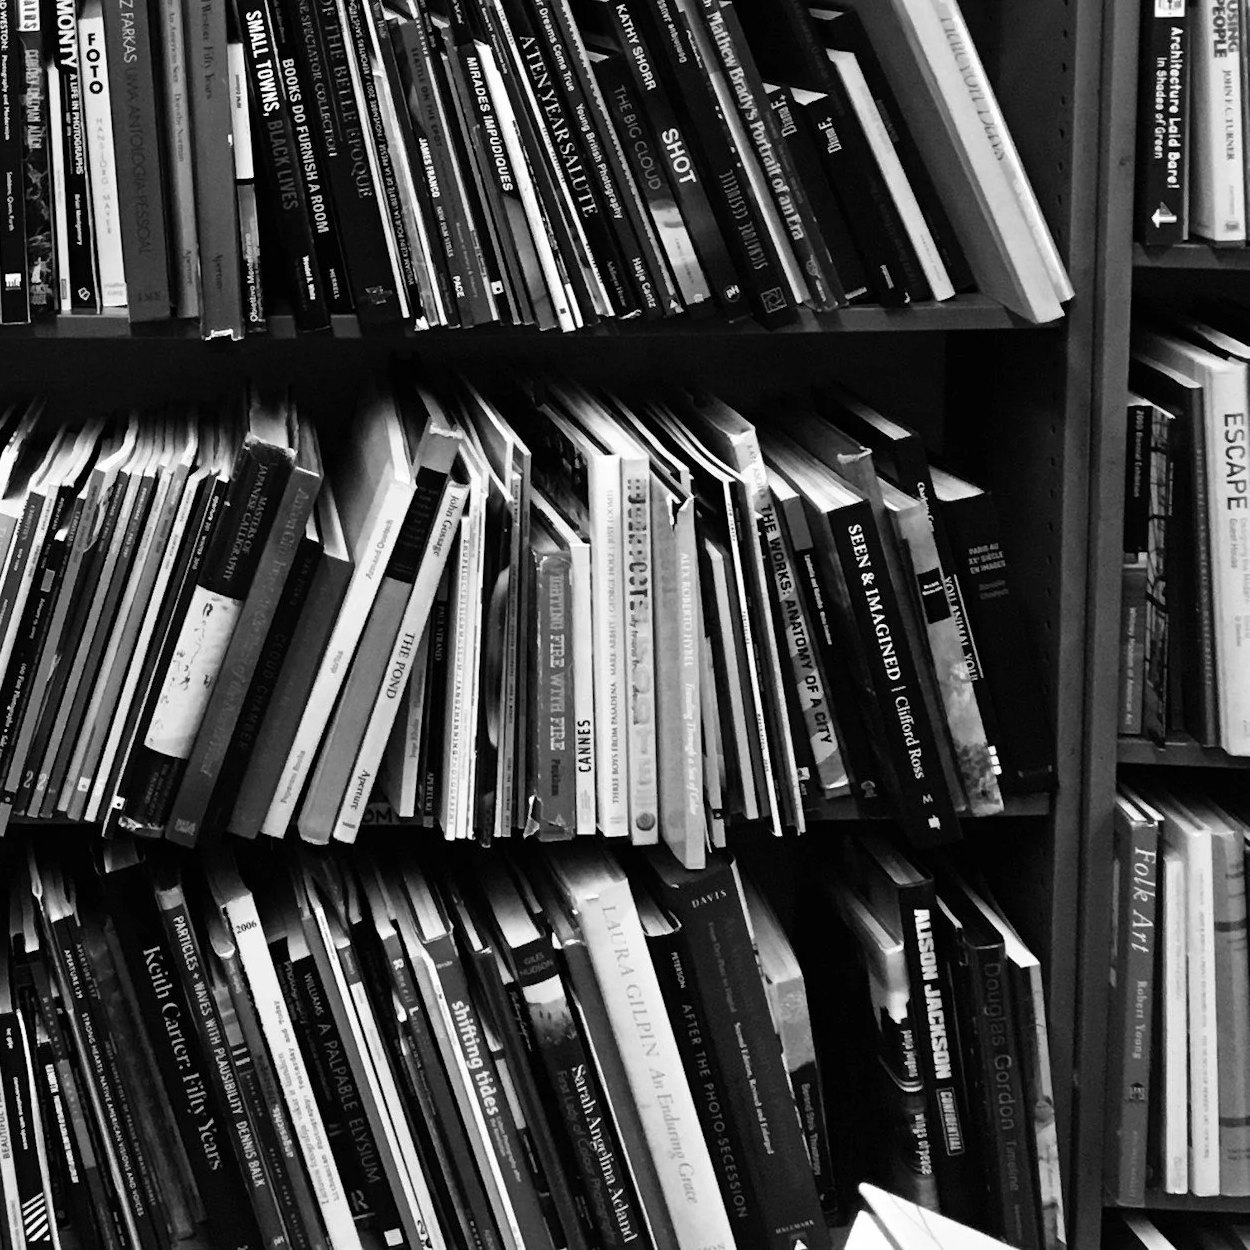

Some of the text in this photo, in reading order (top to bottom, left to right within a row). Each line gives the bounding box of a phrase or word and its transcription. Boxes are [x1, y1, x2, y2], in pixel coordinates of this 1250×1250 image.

[122, 12, 137, 63] FARKAS
[245, 10, 280, 117] SMALL TOWNS,
[467, 56, 492, 112] MIRADES
[615, 4, 657, 90] KATHY SHORR
[282, 58, 329, 234] BOOKS DO FURNISH A ROOM
[661, 128, 697, 184] SHOT
[1166, 27, 1183, 189] Architecture Laid Bare!
[1224, 413, 1247, 510] ESCAPE
[385, 632, 416, 700] THE POND
[848, 523, 927, 780] SEEN & IMAGINED Clifford Ross
[577, 719, 591, 773] CANNES
[1130, 847, 1157, 953] Folk Art
[913, 909, 952, 1079] ALISON JACKSON
[141, 946, 222, 1170] Keith Carter: Fifty Years
[450, 1000, 501, 1116] shifting tides
